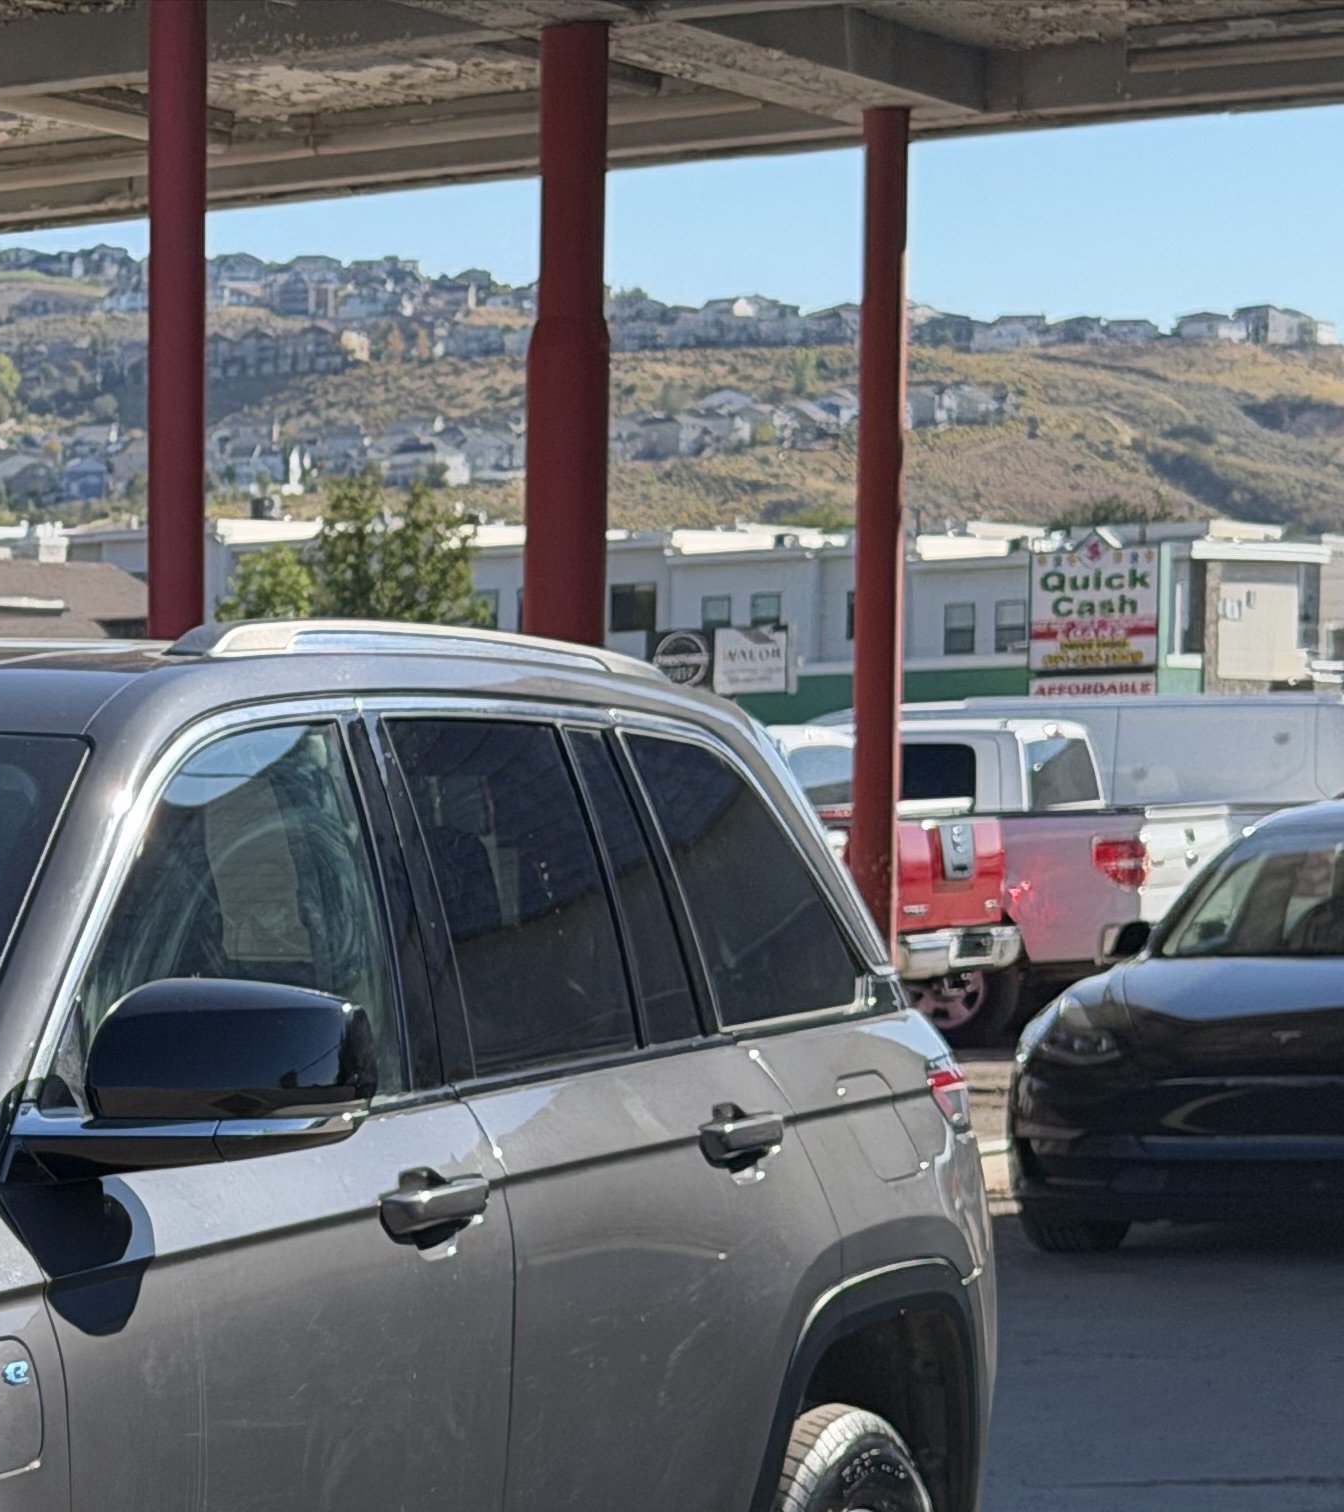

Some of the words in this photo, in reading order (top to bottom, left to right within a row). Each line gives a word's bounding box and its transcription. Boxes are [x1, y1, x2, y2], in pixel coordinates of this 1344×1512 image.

[1040, 567, 1150, 592] Quick
[1052, 594, 1138, 617] Cash
[1034, 681, 1153, 697] AFFORDABLE
